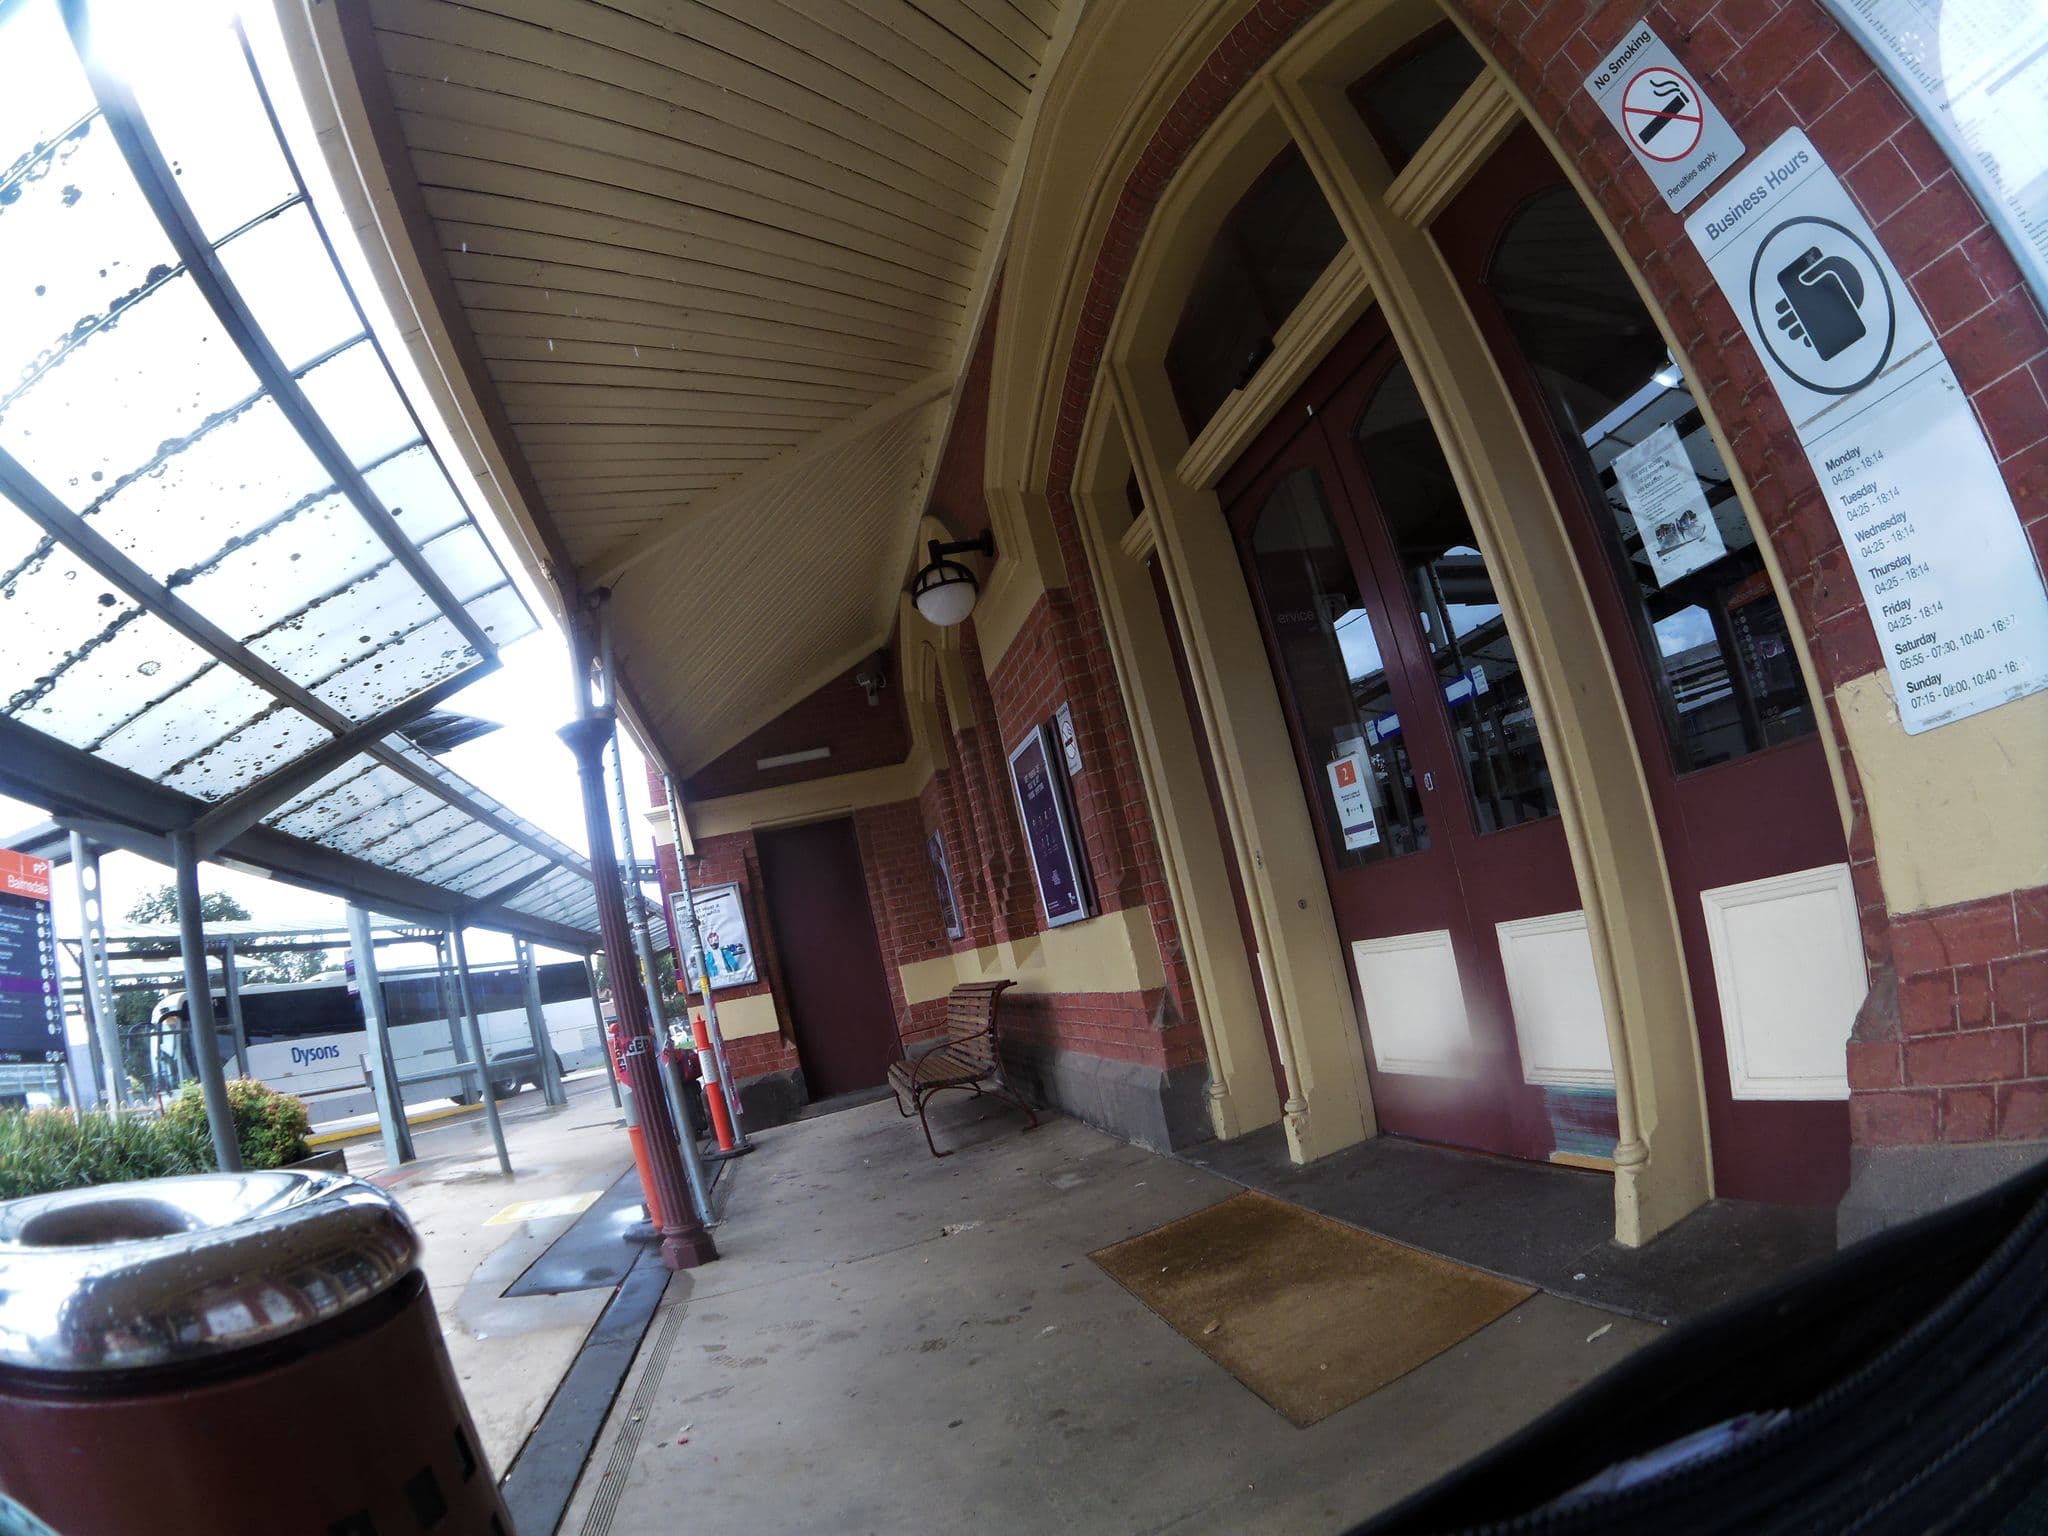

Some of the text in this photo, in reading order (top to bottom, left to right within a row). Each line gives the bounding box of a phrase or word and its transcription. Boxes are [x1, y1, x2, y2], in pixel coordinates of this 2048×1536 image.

[1594, 31, 1652, 90] No Smoking
[1667, 151, 1718, 199] Penalties apply.
[1705, 150, 1809, 241] Business Hours
[1825, 446, 1861, 473] Monday
[1832, 466, 1855, 486] 04:25
[1861, 450, 1884, 469] 18:14
[1840, 481, 1878, 507] Tuesday
[1846, 502, 1871, 522] 04:25
[1877, 486, 1900, 505] 18:14
[1854, 510, 1907, 543] Wednesday
[1861, 538, 1885, 558] 04:25
[1892, 524, 1915, 543] 18:14
[1868, 553, 1912, 580] Thursday
[1874, 576, 1899, 595] 04:25
[1906, 561, 1930, 581] 18:14
[1882, 598, 1912, 617] Friday
[1887, 614, 1912, 633] 04:25
[1919, 600, 1944, 619] 18:14
[1894, 631, 1937, 656] Saturday
[1899, 652, 1925, 671] 05:55
[1931, 639, 1959, 659] 07:30,
[1960, 628, 1985, 647] 10:40
[1906, 672, 1942, 693] Sunday
[1911, 691, 1936, 709] 07:15
[1972, 668, 1997, 686] 10:40
[291, 1045, 340, 1067] Dysons
